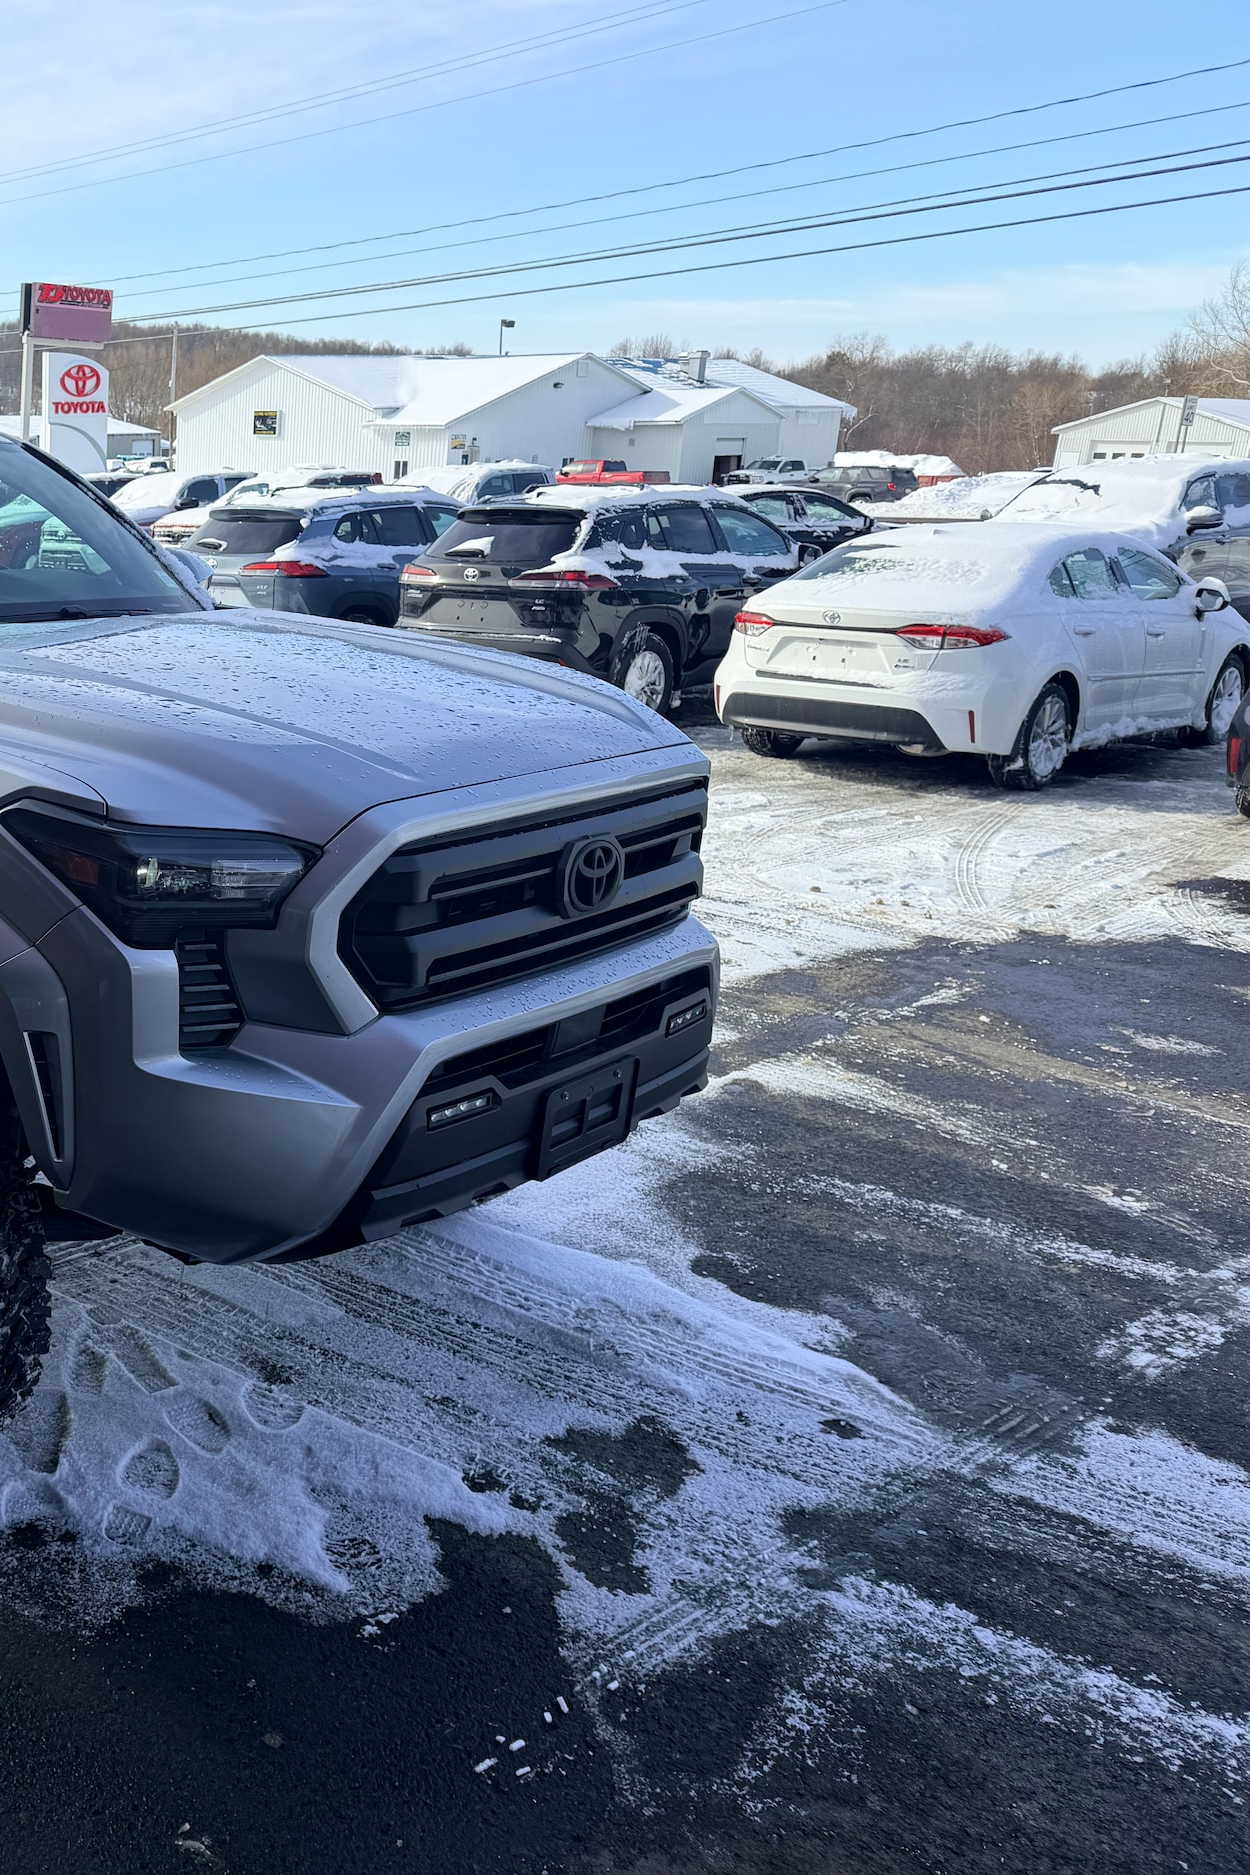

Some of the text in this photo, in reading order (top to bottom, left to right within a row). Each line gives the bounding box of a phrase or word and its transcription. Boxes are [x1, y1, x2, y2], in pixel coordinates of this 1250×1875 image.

[38, 283, 112, 305] TJ TOYOTA
[51, 401, 107, 415] TOYOTA
[1184, 411, 1195, 423] 40
